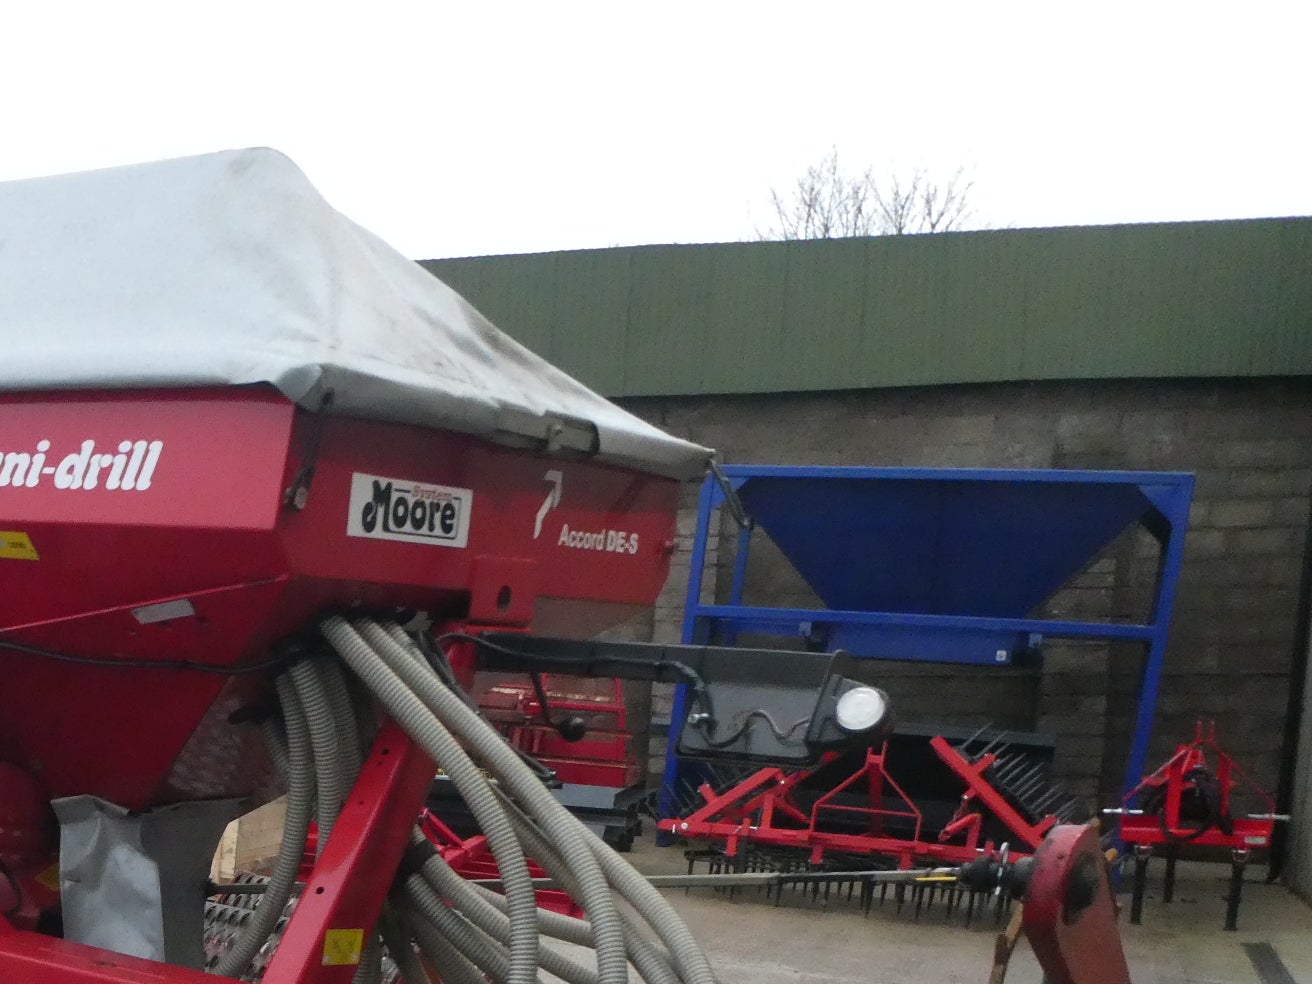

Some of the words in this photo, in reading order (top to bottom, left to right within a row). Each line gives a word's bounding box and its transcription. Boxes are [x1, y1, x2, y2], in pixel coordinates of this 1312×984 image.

[362, 480, 456, 534] Moore
[558, 523, 606, 550] Accord
[606, 530, 639, 554] DE-S
